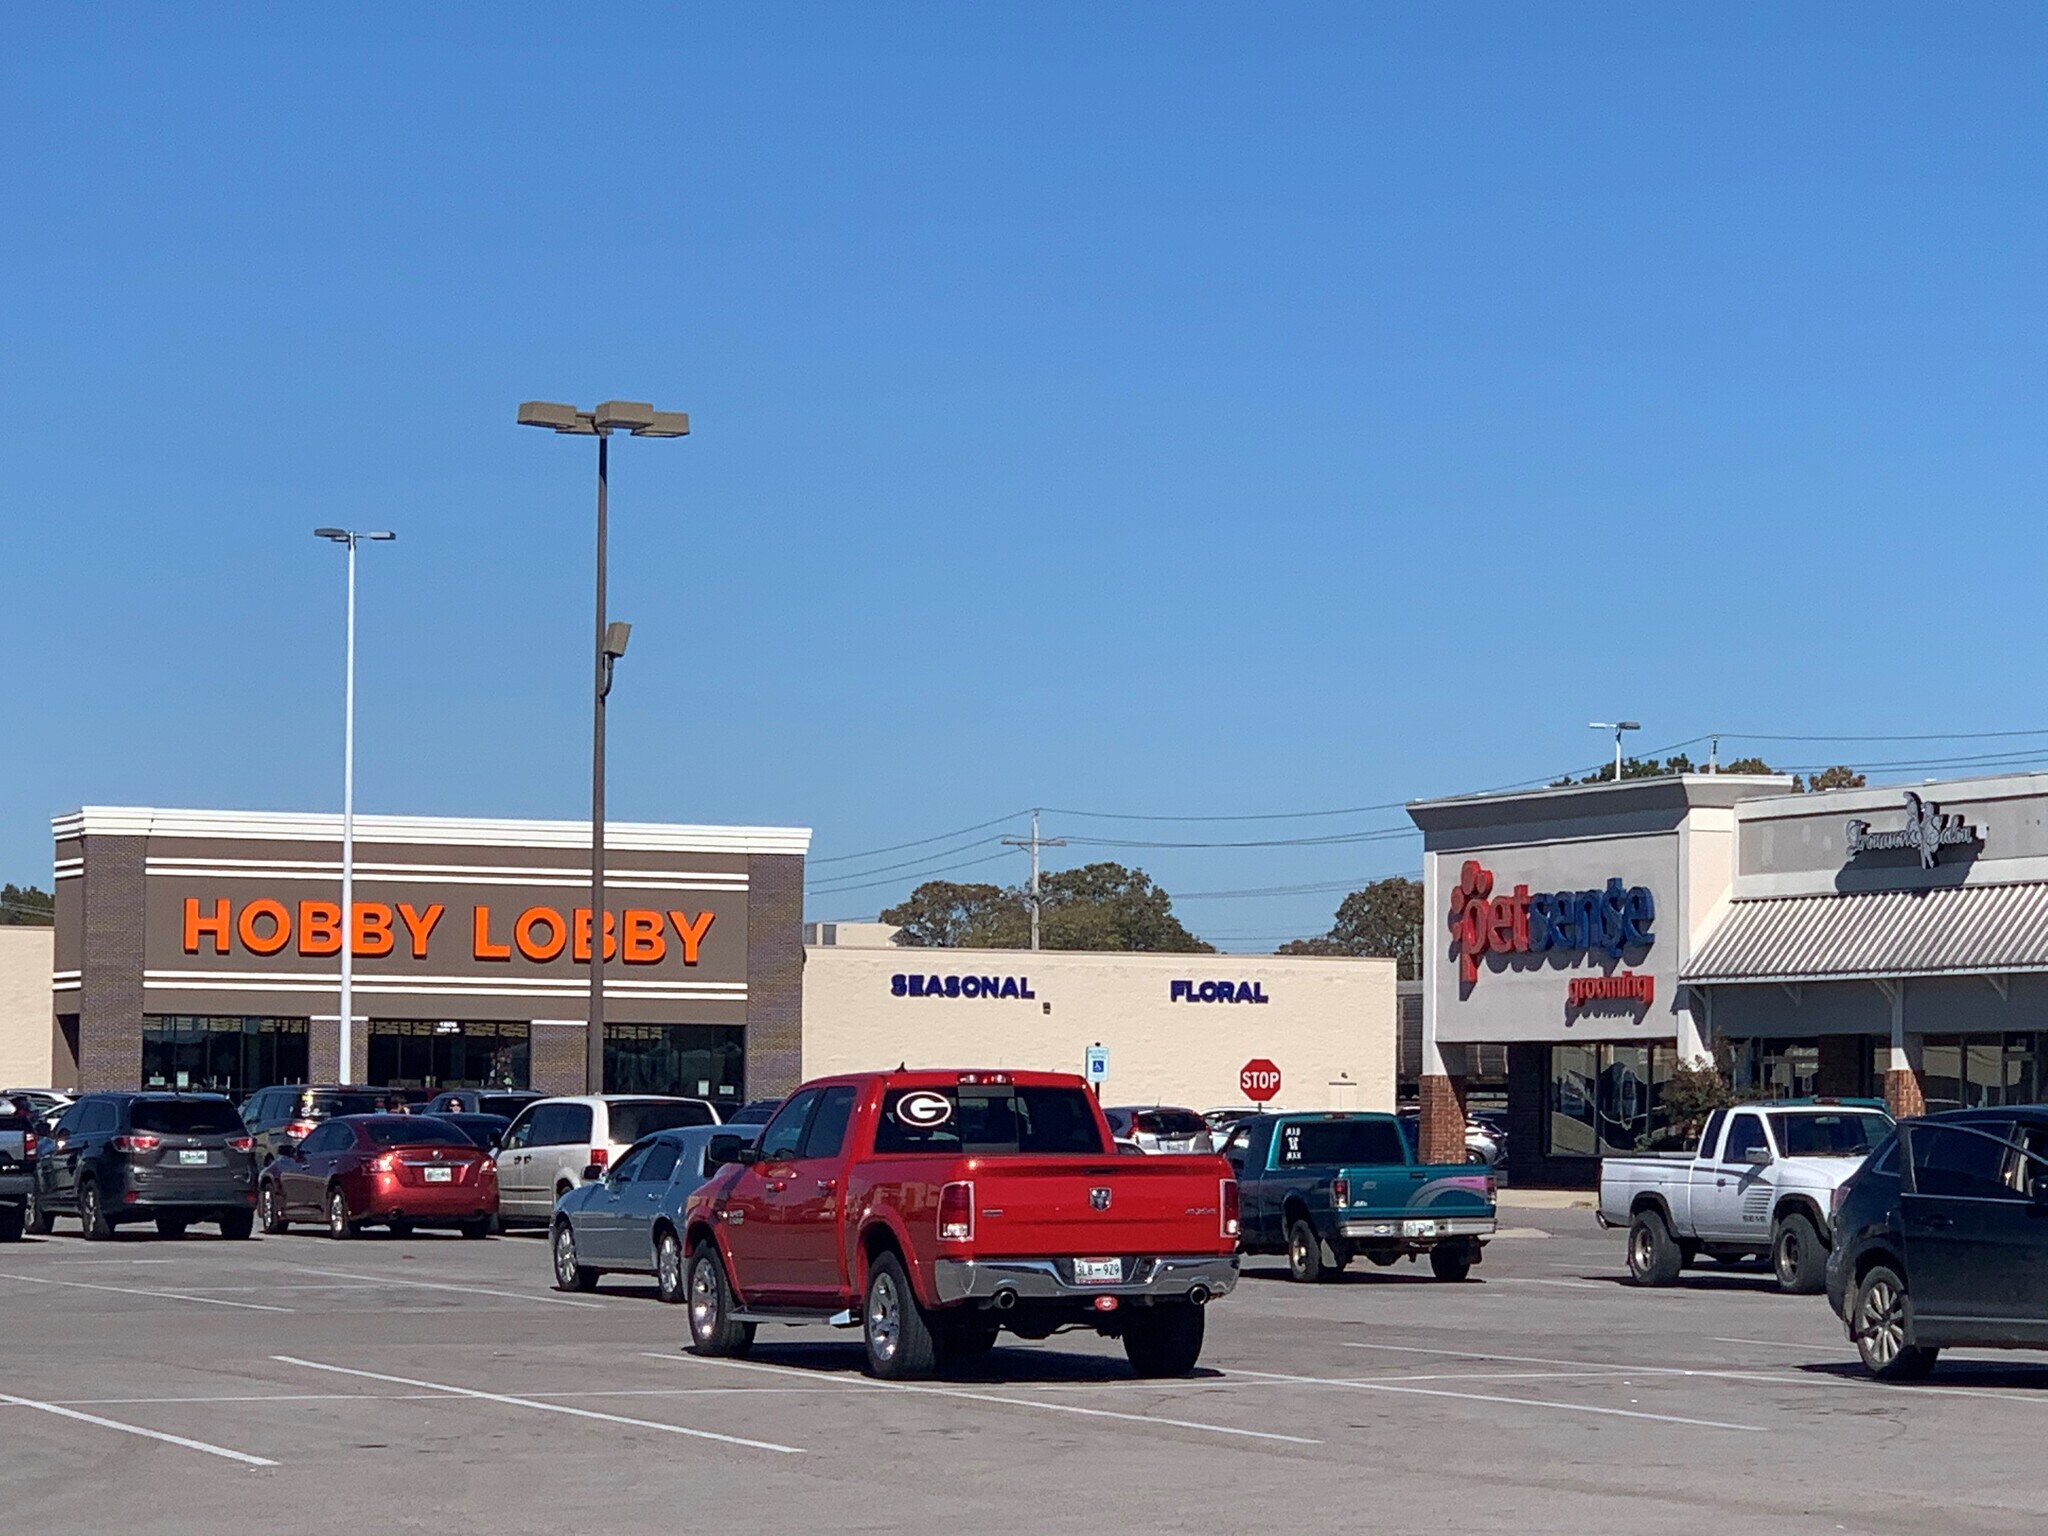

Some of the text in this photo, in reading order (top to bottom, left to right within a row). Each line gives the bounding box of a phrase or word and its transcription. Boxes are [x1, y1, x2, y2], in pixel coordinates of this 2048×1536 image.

[184, 897, 716, 967] HOBBY LOBBY
[1461, 877, 1656, 982] petsense
[890, 973, 1036, 1000] SEASONAL
[1170, 979, 1270, 1004] FLORAL
[1568, 970, 1655, 1007] grooming
[1241, 1070, 1280, 1089] STOP
